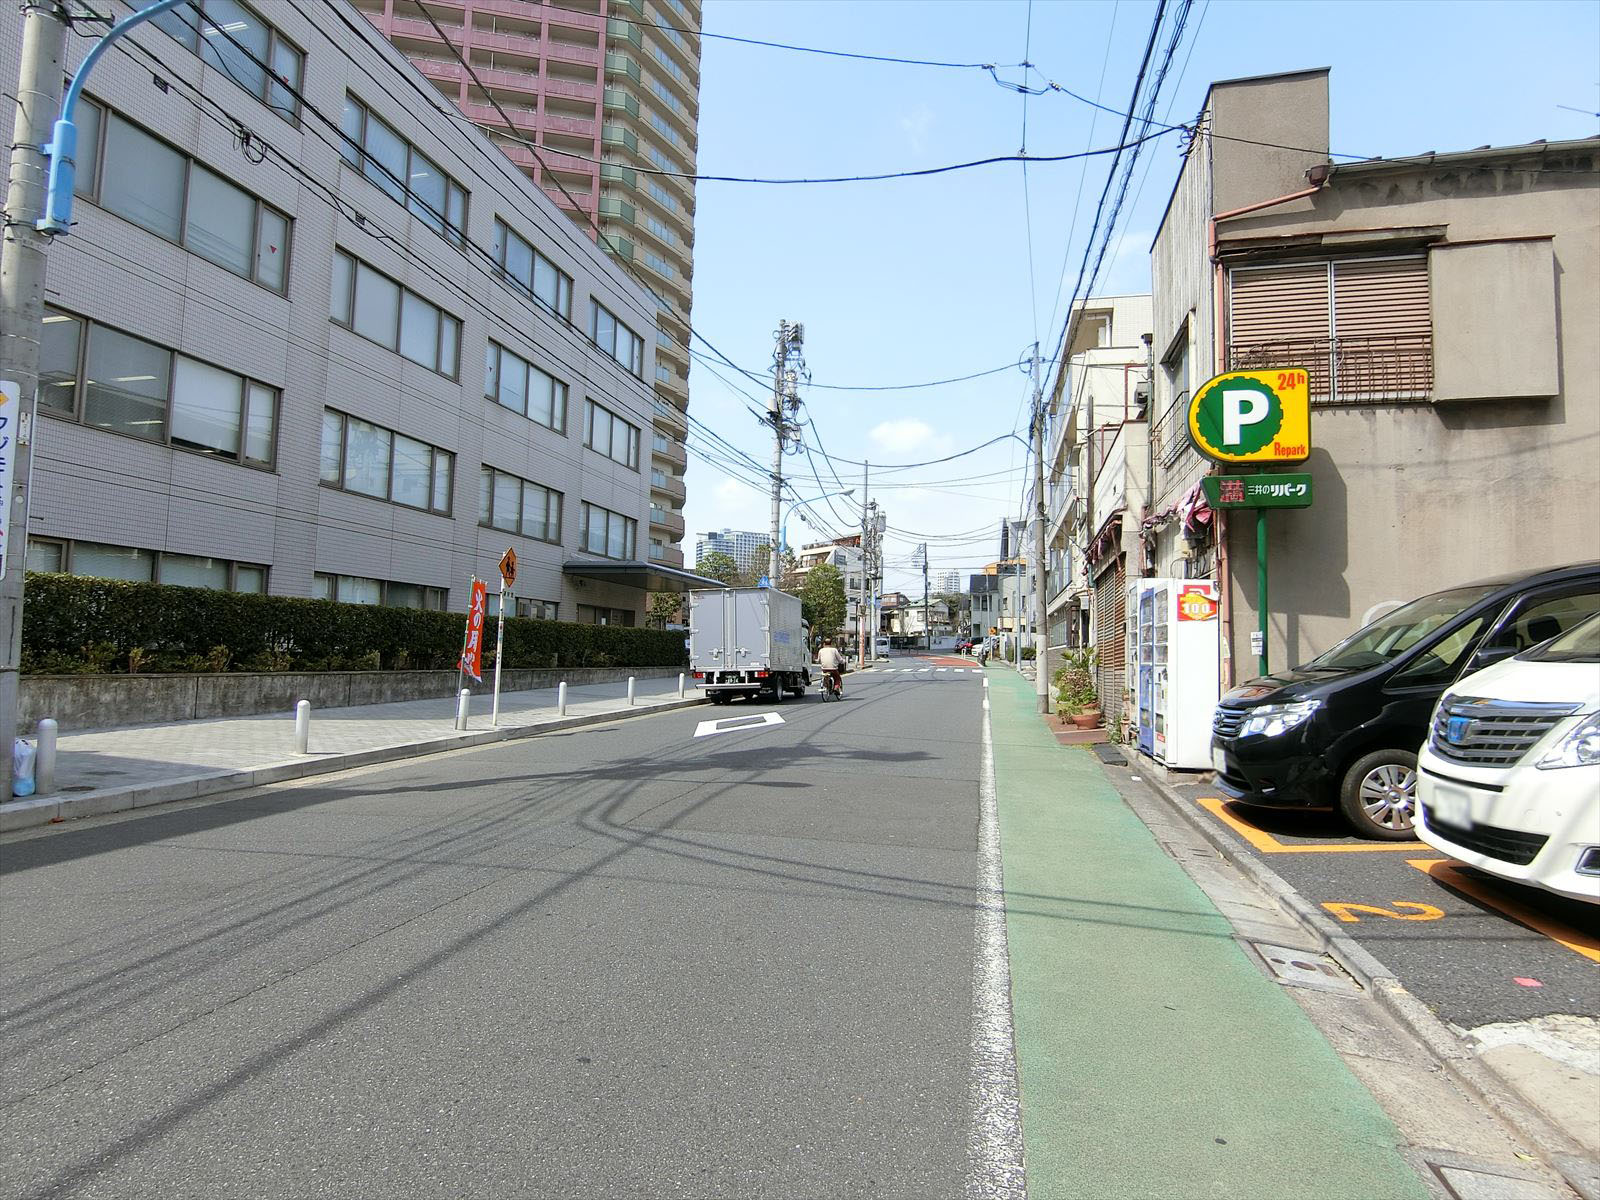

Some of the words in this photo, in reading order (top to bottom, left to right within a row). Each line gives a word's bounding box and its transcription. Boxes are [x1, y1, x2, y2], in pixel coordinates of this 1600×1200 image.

[1223, 390, 1269, 446] P
[1274, 442, 1306, 458] Repark
[1247, 483, 1307, 497] 三井のリパーク
[1182, 603, 1211, 615] 100
[1320, 901, 1445, 923] 2
